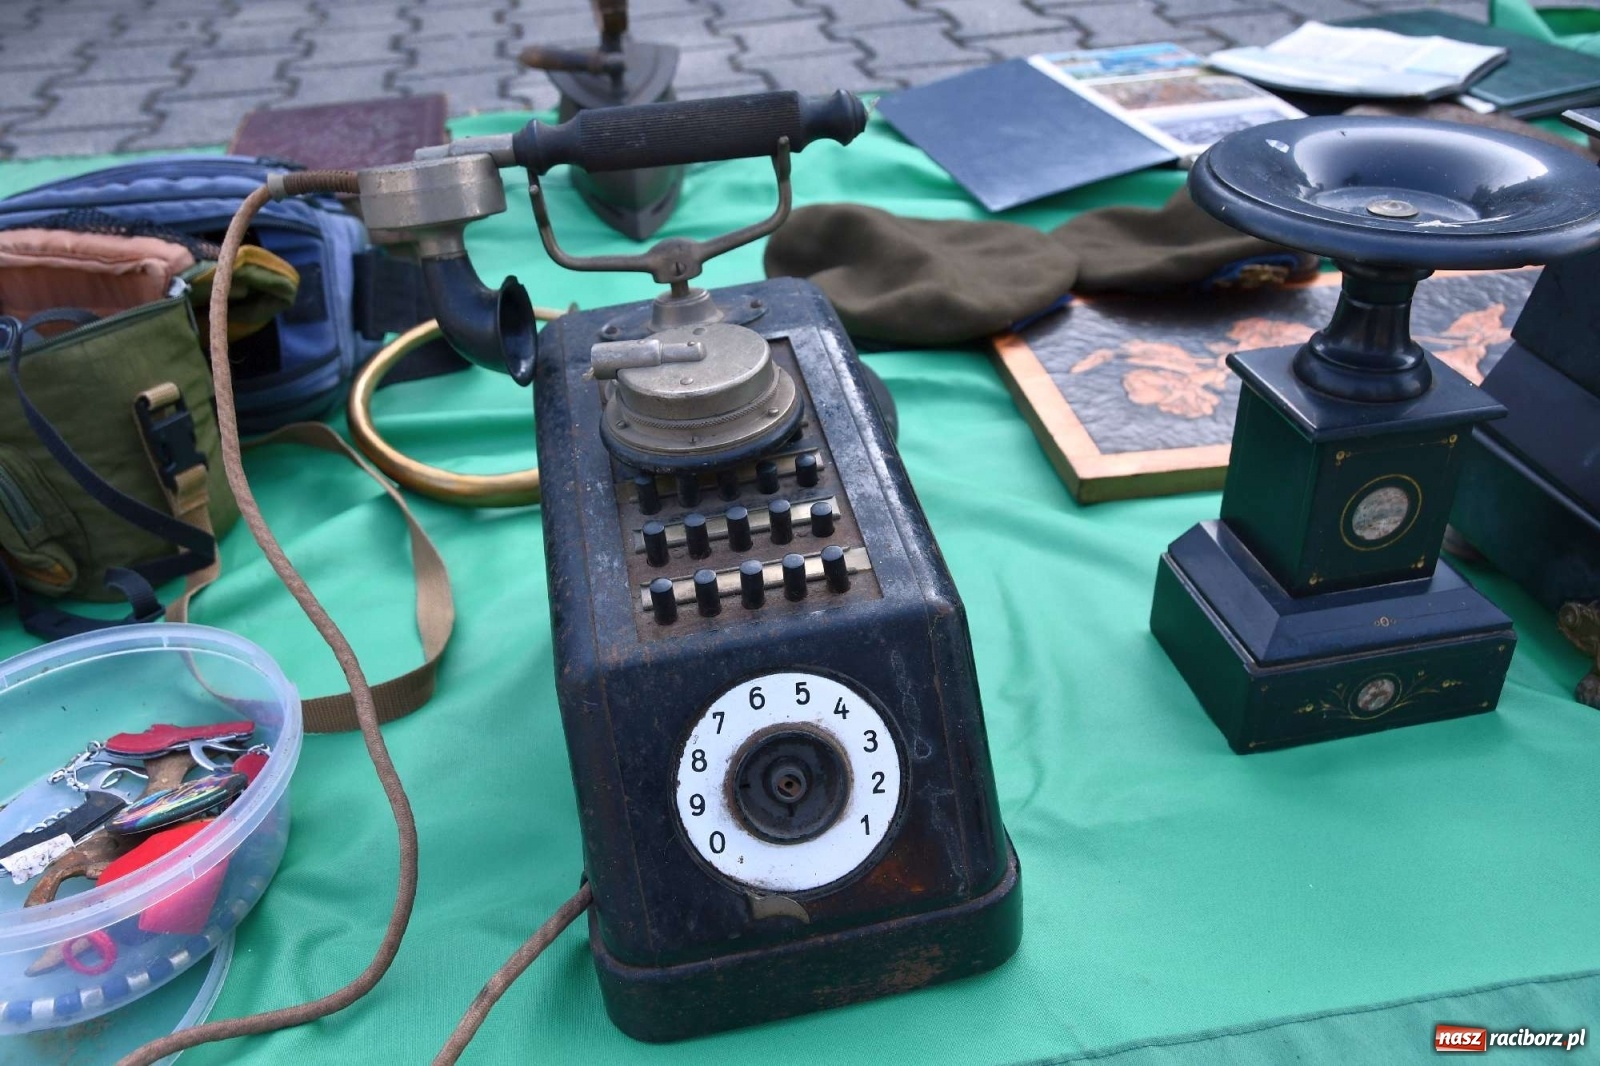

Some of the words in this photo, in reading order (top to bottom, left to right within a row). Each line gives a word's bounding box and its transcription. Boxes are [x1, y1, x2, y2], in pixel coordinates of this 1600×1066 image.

[750, 686, 765, 710] 6
[795, 682, 810, 705] 5
[833, 697, 849, 719] 4
[713, 712, 725, 734] 7
[863, 730, 878, 753] 3
[691, 749, 707, 772] 8
[871, 771, 885, 794] 2
[690, 794, 706, 816] 9
[861, 815, 870, 835] 1
[709, 831, 726, 853] 0
